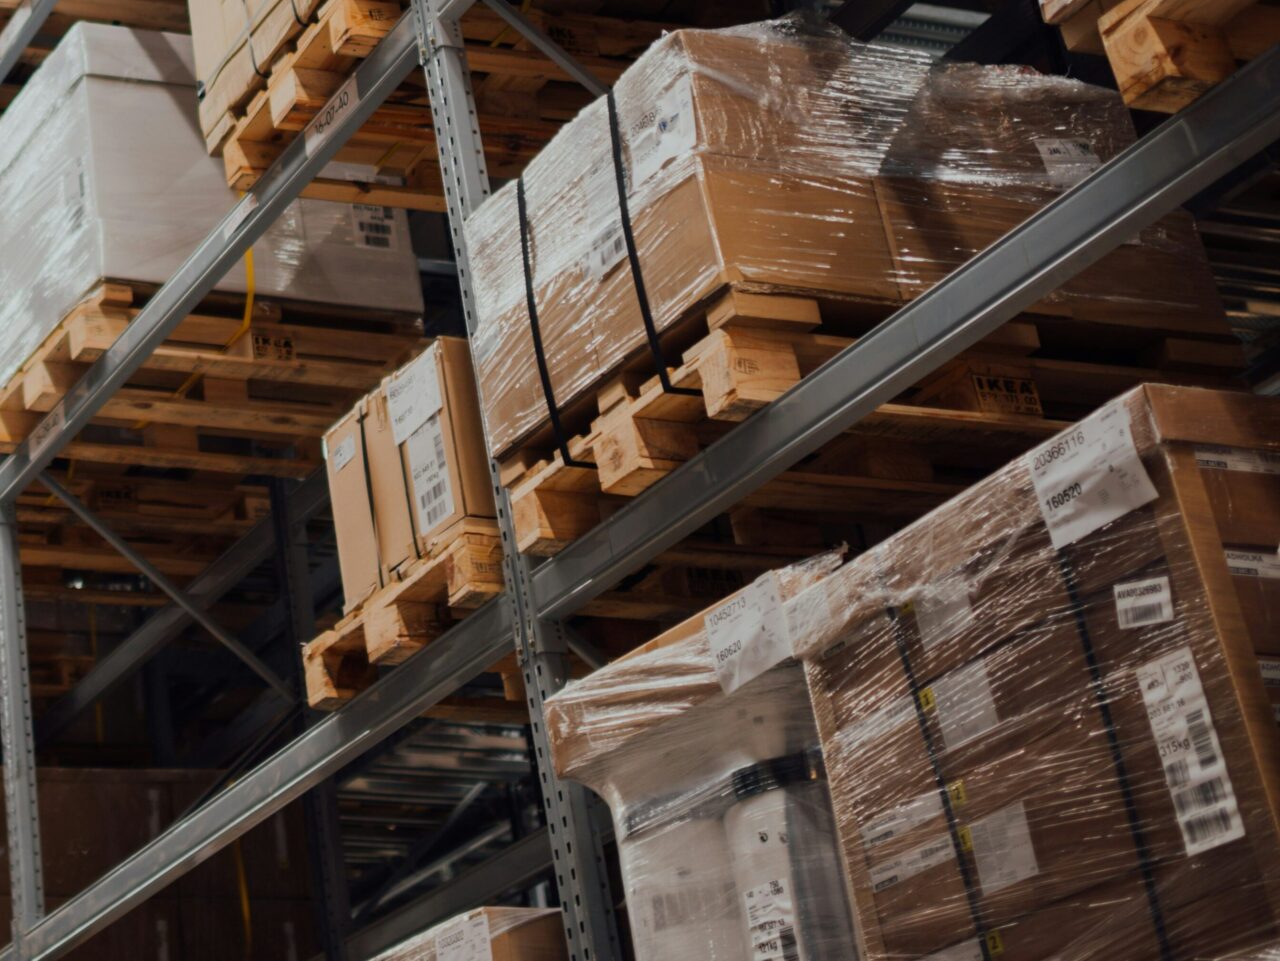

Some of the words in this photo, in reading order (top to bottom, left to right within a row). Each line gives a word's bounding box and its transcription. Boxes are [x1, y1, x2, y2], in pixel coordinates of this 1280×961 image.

[314, 91, 349, 134] 16-07-40
[976, 377, 1034, 395] IKEA
[1033, 431, 1085, 472] 20366116
[1045, 482, 1082, 512] 160520
[709, 596, 746, 627] 10452713
[716, 639, 741, 664] 160620
[1160, 737, 1191, 758] 315kg
[954, 787, 962, 800] 2
[990, 935, 999, 949] 2
